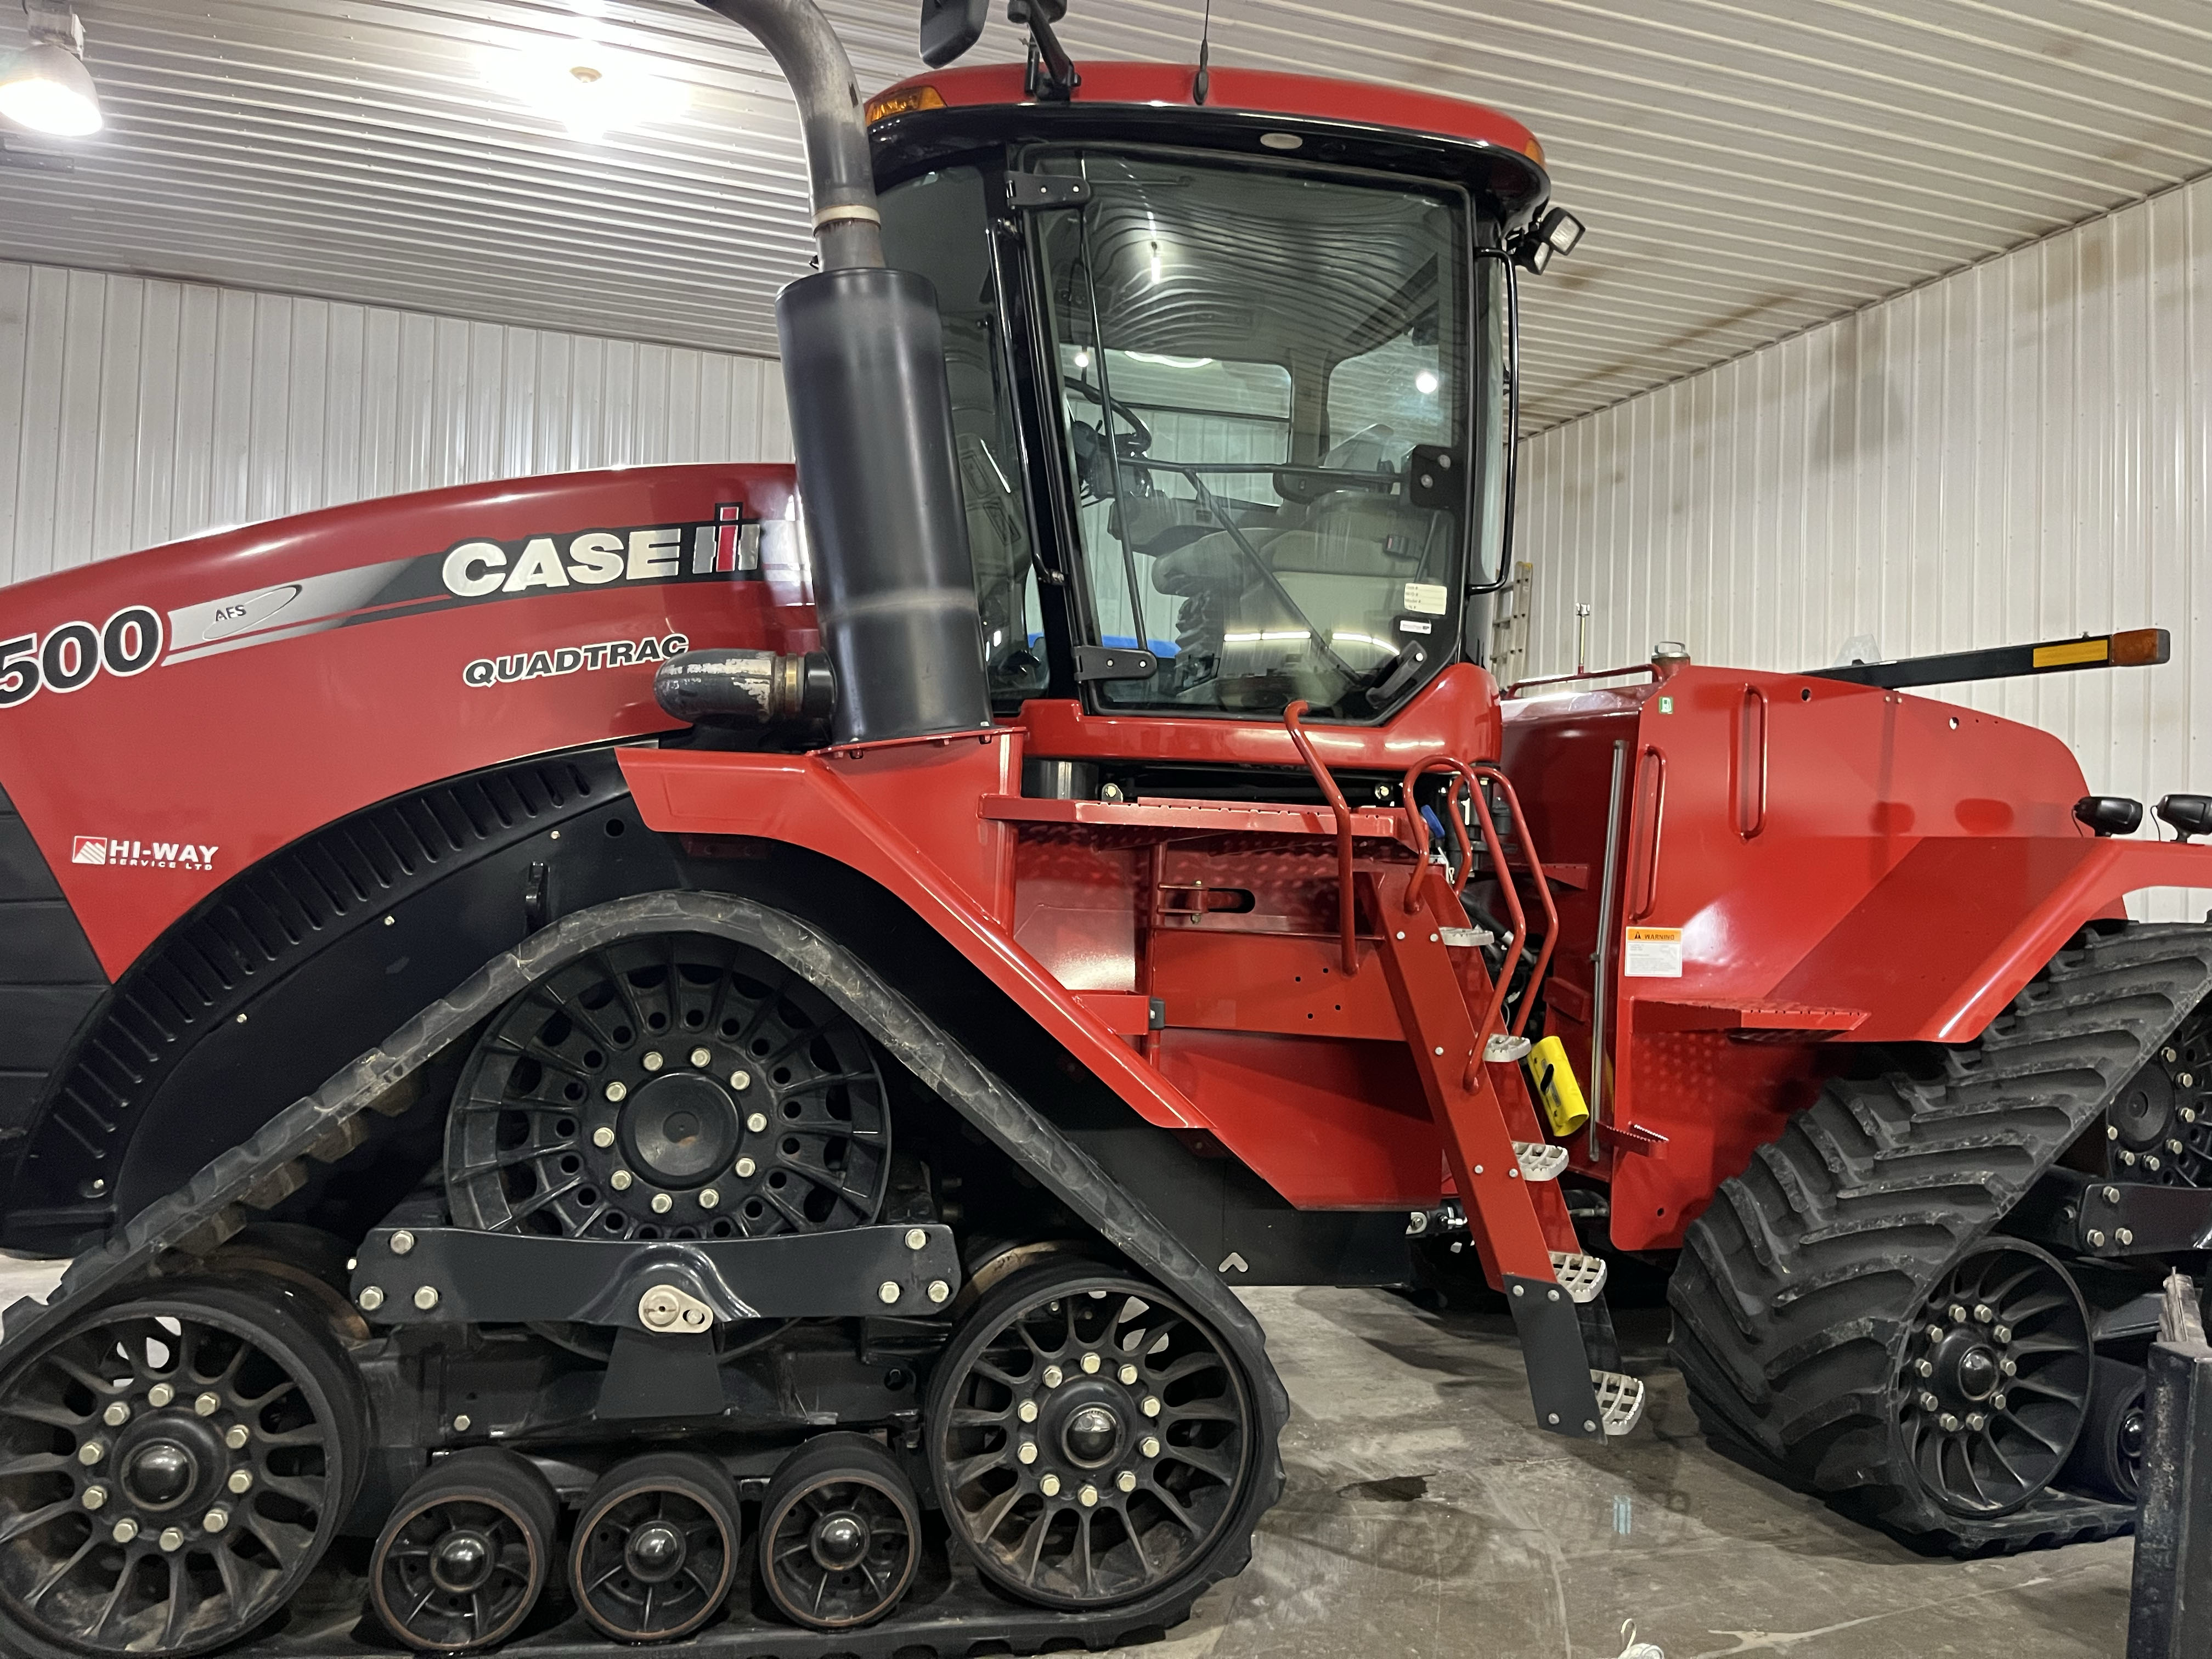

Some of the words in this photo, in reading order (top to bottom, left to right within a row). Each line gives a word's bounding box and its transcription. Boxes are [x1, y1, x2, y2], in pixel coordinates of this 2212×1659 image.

[442, 528, 681, 597] CASE
[216, 605, 247, 622] AFS
[0, 605, 163, 709] 500
[462, 633, 689, 688] QUADTRAC
[110, 839, 219, 863] HI-WAY
[110, 858, 176, 868] SERVICE
